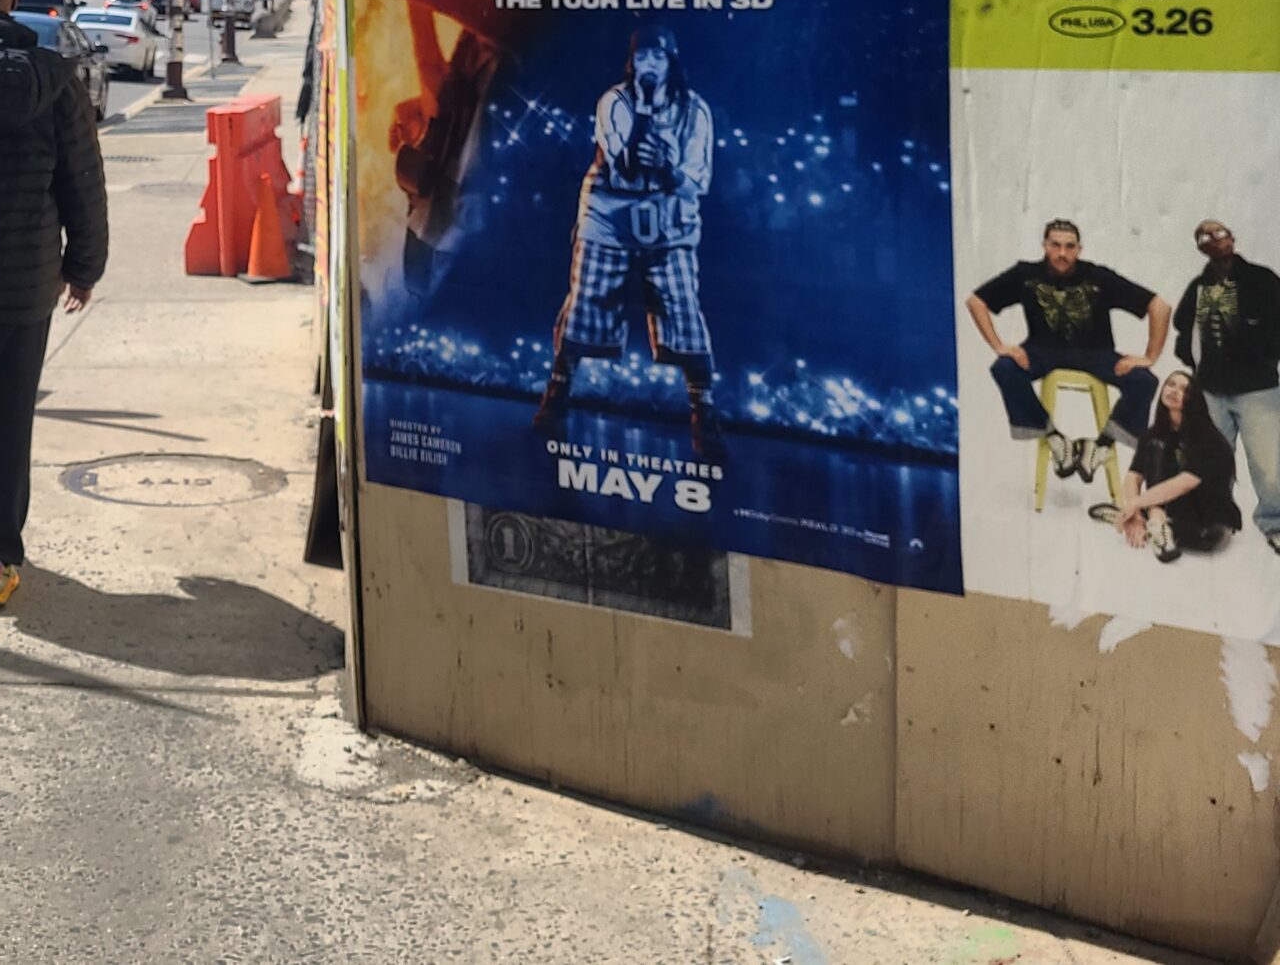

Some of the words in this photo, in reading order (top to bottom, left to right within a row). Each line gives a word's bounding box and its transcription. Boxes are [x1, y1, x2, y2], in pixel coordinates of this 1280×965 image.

[1088, 17, 1114, 27] USA
[1131, 7, 1214, 36] 3.26
[390, 444, 418, 461] BILLIE
[420, 449, 448, 466] EILISH
[391, 430, 419, 446] JAMES
[421, 435, 462, 455] CAMERON
[546, 439, 594, 458] ONLY
[600, 448, 619, 463] IN
[625, 452, 723, 481] THEATRES
[558, 458, 663, 504] MAY
[674, 479, 712, 513] 8
